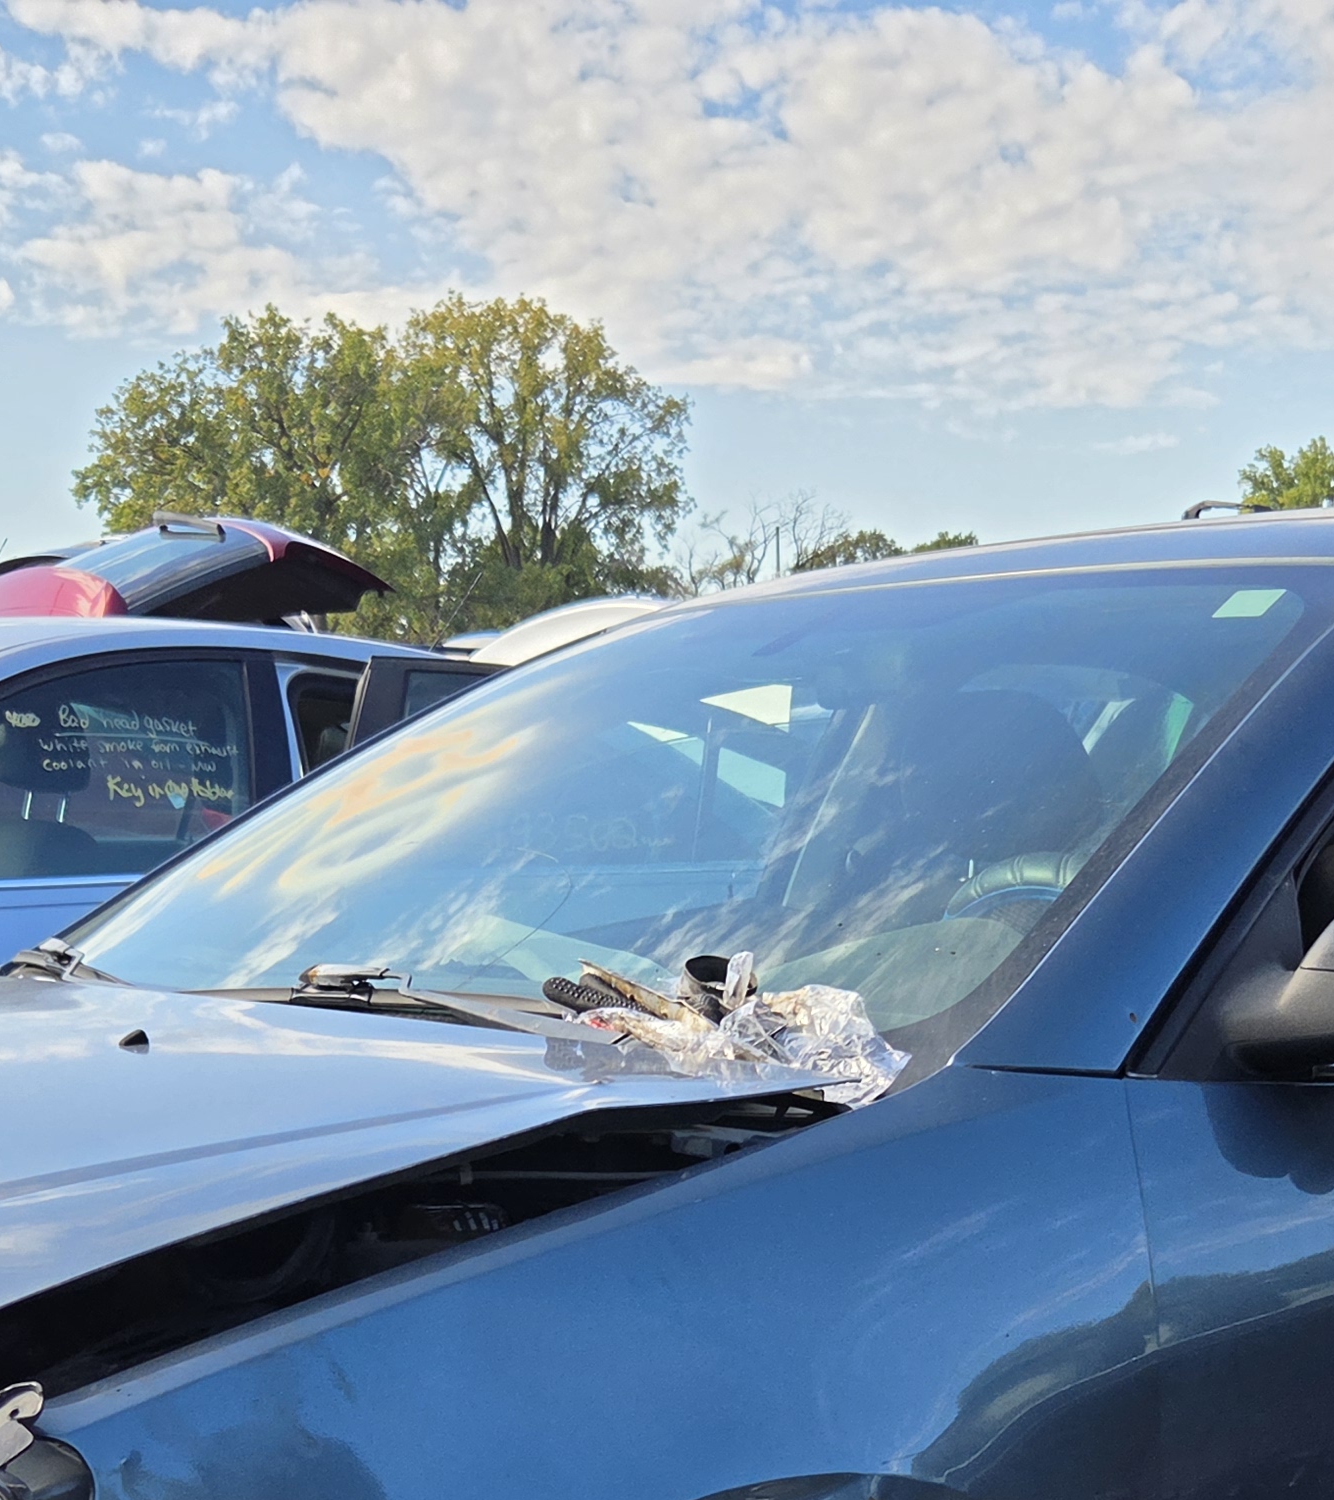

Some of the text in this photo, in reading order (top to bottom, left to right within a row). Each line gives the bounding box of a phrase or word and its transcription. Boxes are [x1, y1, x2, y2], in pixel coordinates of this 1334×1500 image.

[58, 704, 89, 729] Bad
[100, 709, 139, 731] head
[144, 716, 197, 738] gasket
